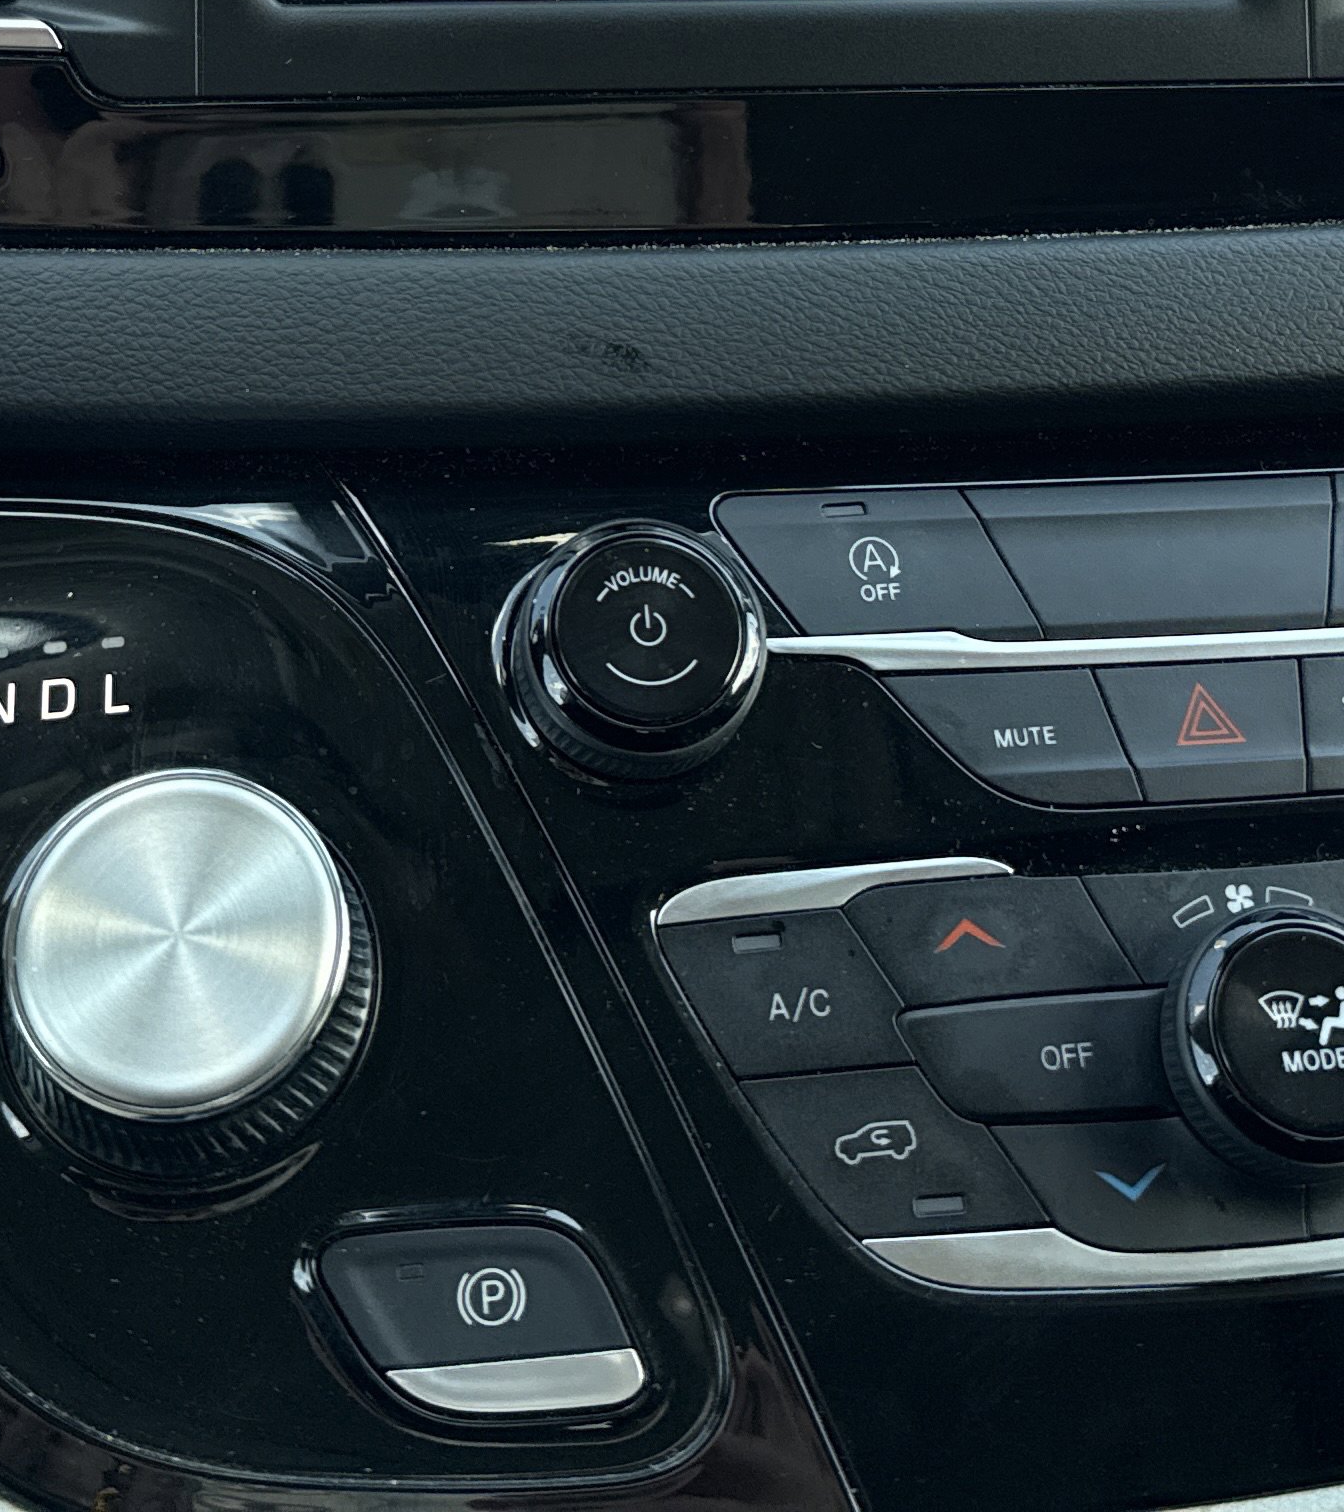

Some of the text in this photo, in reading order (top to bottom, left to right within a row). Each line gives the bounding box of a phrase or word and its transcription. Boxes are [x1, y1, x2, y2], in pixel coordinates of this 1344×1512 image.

[604, 566, 681, 591] VOLUME
[860, 583, 901, 602] OFF
[994, 726, 1056, 747] MUTE
[770, 988, 830, 1022] A/C
[1041, 1043, 1091, 1070] OFF
